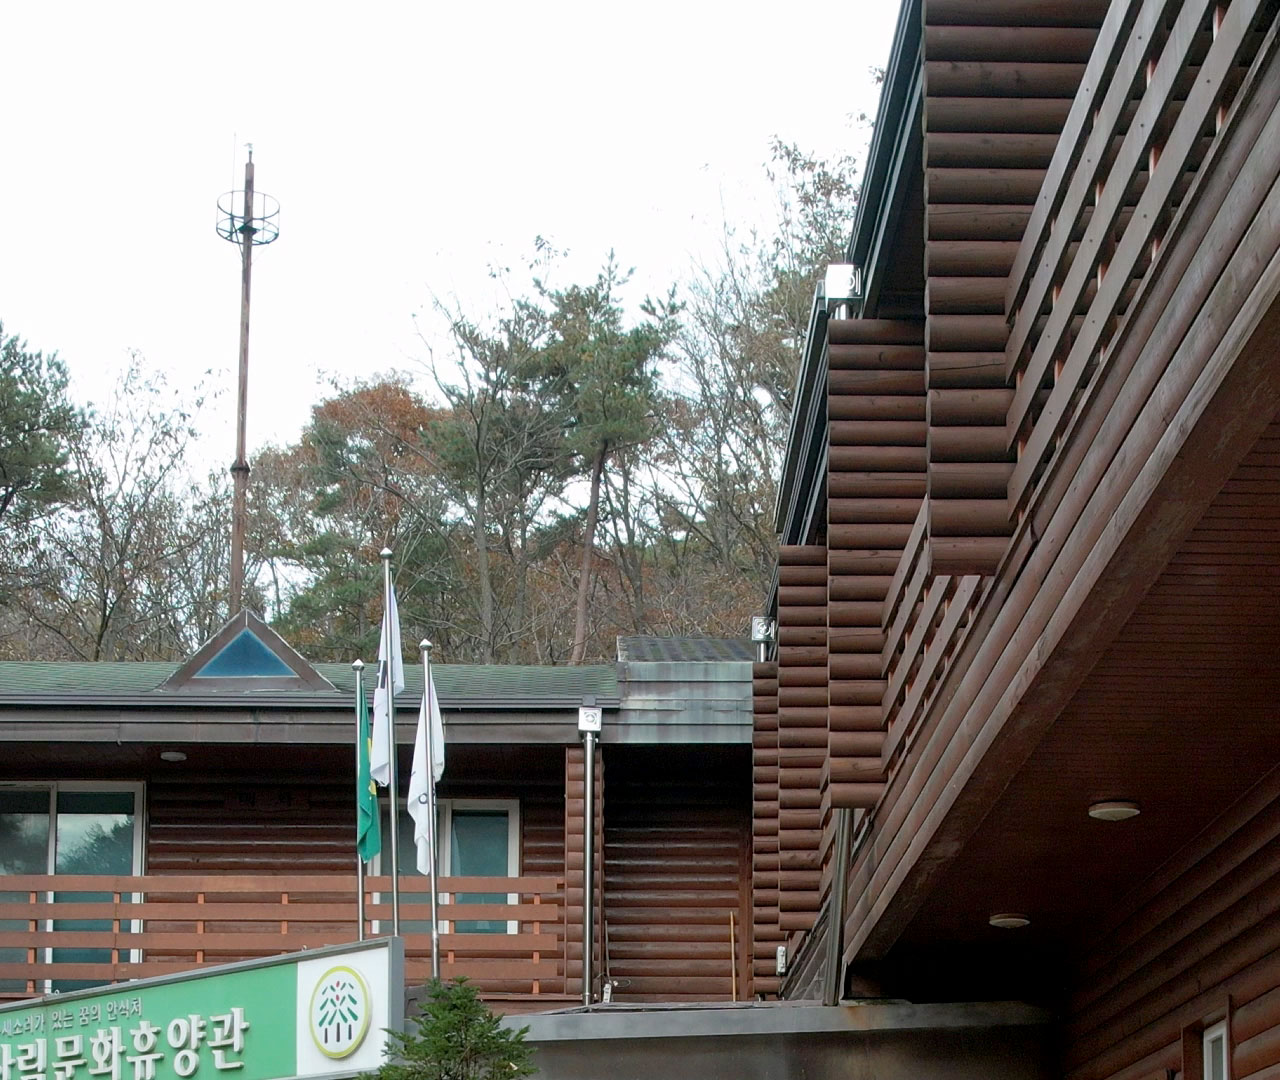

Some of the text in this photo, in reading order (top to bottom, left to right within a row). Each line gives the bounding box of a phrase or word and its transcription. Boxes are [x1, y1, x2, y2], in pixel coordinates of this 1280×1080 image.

[51, 1010, 74, 1030] 있는
[78, 1003, 102, 1026] 꿈의
[106, 997, 143, 1022] 안식처
